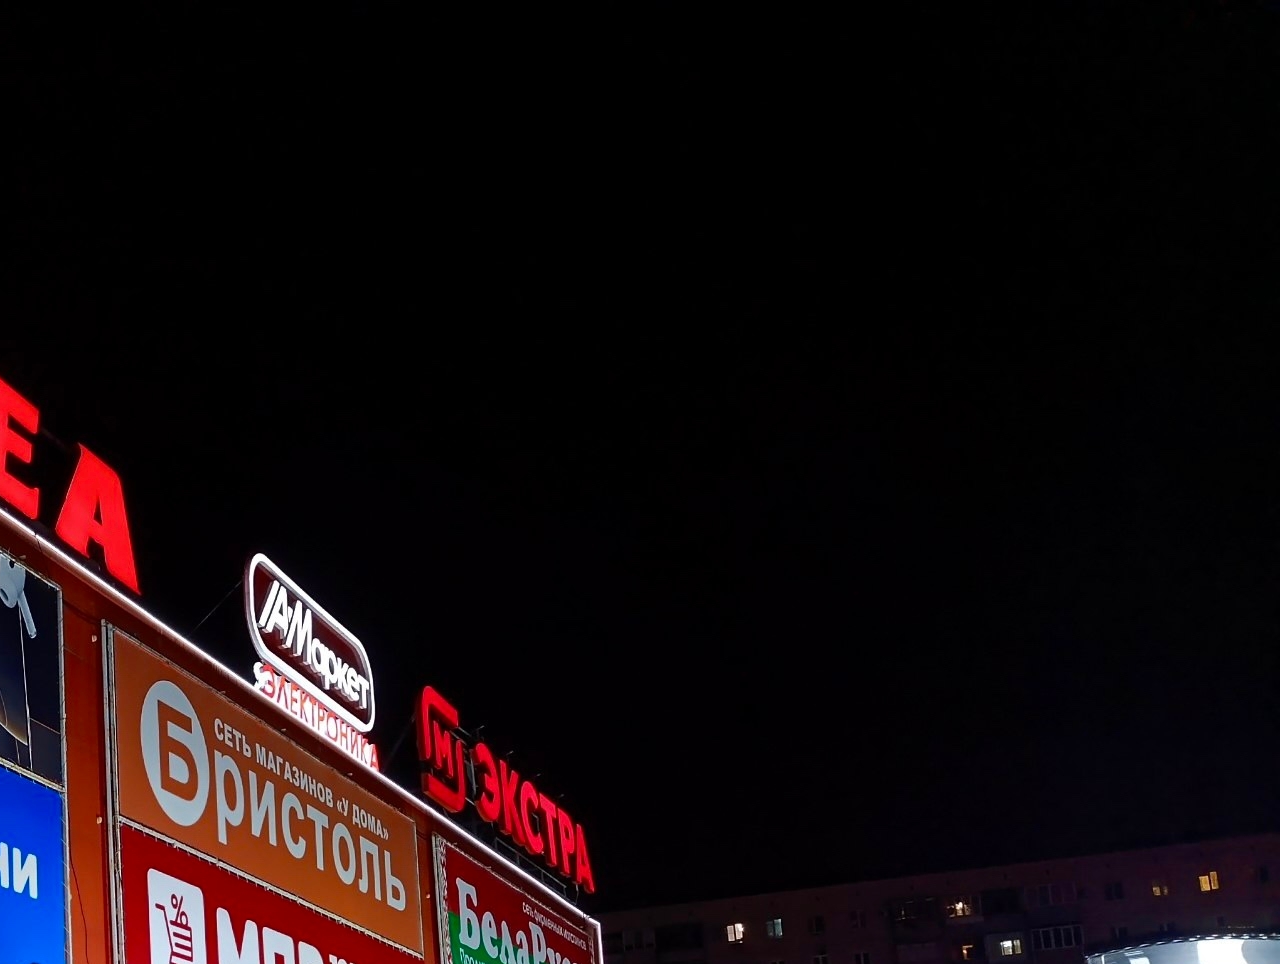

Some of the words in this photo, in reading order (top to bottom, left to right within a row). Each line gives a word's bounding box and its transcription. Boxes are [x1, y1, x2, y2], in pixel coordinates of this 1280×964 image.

[214, 718, 252, 758] СЕТЬ
[256, 743, 333, 808] МАГАЗИНОВ
[262, 664, 380, 772] ЭЛЕКТРОНИКА
[475, 743, 595, 894] ЭКСТРА
